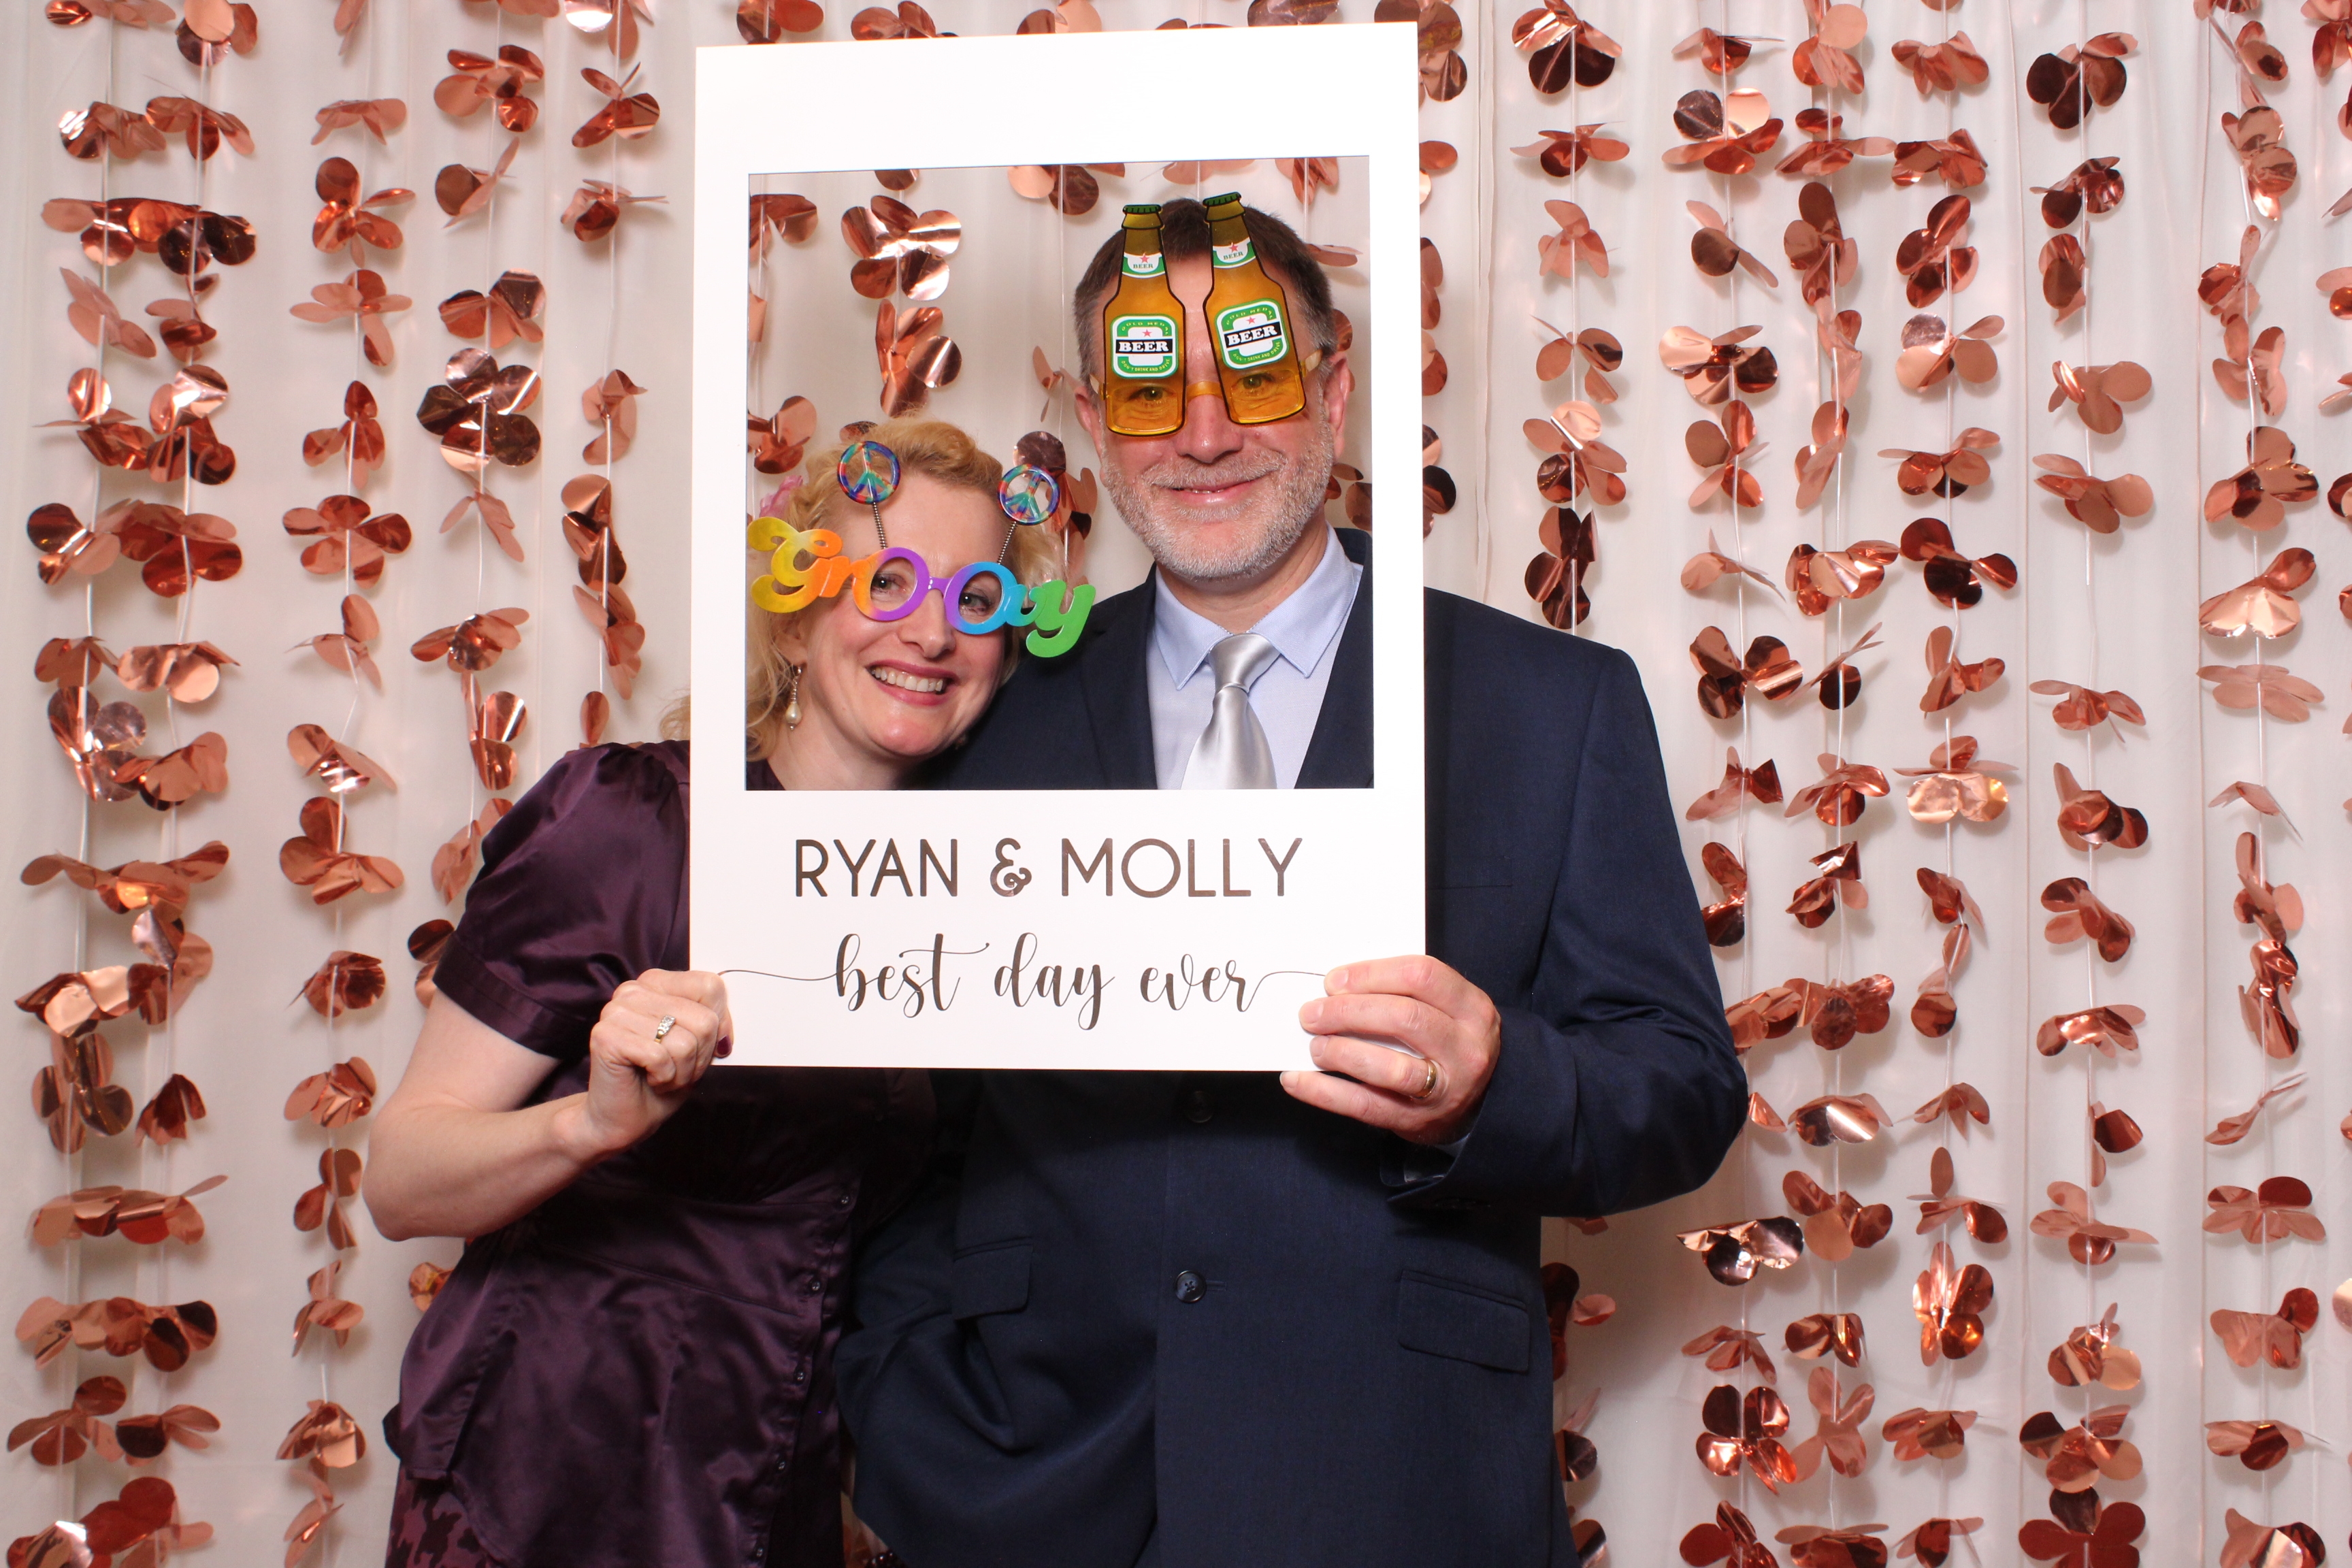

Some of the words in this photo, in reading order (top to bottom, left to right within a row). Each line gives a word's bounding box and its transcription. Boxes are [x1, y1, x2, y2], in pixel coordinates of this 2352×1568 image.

[1223, 251, 1244, 260] BEER
[1250, 307, 1273, 319] MEDAL
[1122, 322, 1143, 331] GOLD
[1147, 322, 1169, 336] MEDAL
[1226, 325, 1278, 346] BEER
[1118, 341, 1169, 353] BEER
[795, 838, 958, 897] RYAN
[990, 837, 1032, 897] &
[1061, 837, 1302, 898] MOLLY
[832, 933, 990, 1018] best
[994, 932, 1115, 1030] day
[1140, 954, 1267, 1012] ever
